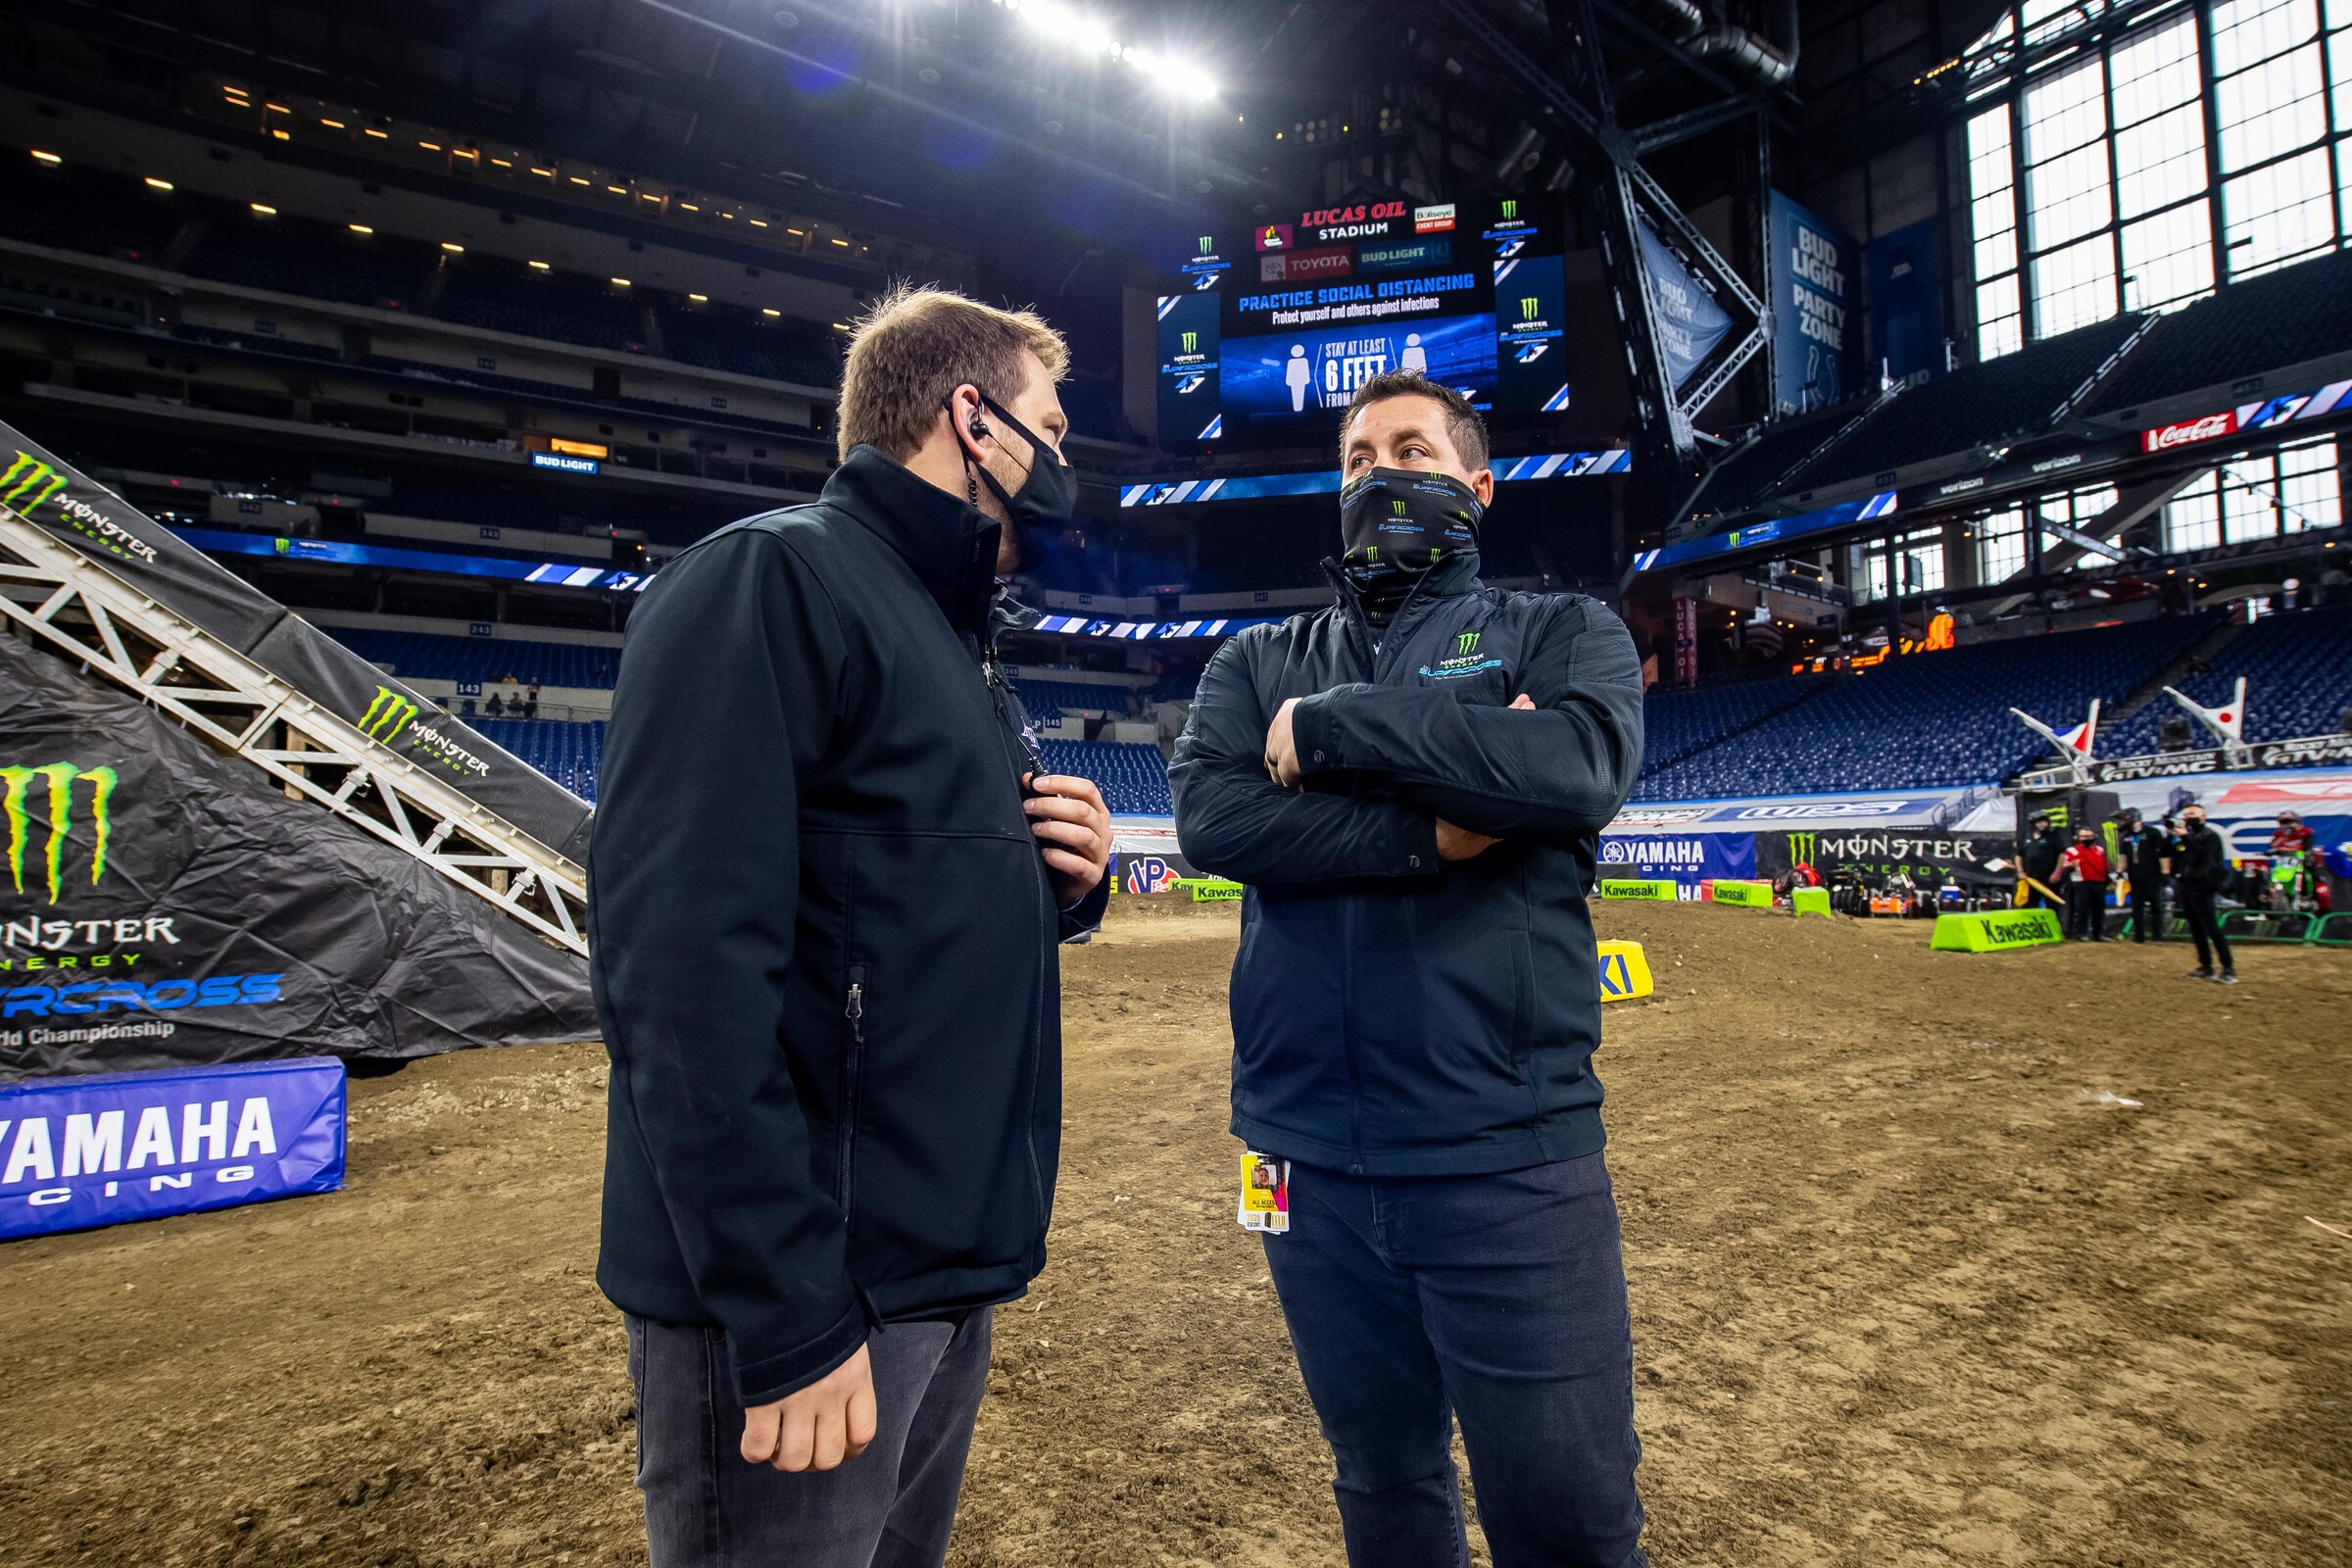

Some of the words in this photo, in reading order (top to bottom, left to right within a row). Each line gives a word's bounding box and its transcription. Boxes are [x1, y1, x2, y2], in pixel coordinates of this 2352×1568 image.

[1301, 205, 1366, 227] LUCAS
[1372, 201, 1406, 219] OIL
[1319, 222, 1389, 240] STADIUM
[1361, 252, 1388, 263] BUD
[1389, 247, 1425, 260] LIGHT
[1798, 225, 1838, 268] BUD
[1291, 255, 1350, 271] TOYOTA
[1791, 247, 1844, 295] LIGHT
[1239, 293, 1313, 312] PRACTICE
[1319, 284, 1374, 304] SOCIAL
[1378, 273, 1474, 297] DISTANCING
[1272, 311, 1299, 324] Protect
[1299, 307, 1331, 323] yourself
[1331, 305, 1346, 318] and
[1347, 302, 1371, 317] others
[1372, 299, 1400, 316] against
[1400, 296, 1439, 312] infections
[1792, 283, 1845, 329] PARTY
[1800, 312, 1842, 351] ZONE
[1326, 342, 1346, 358] STAY
[1348, 340, 1357, 356] AT
[1359, 338, 1386, 355] LEAST
[1326, 359, 1339, 392] 6
[1343, 355, 1388, 391] FEET
[1326, 392, 1351, 408] FROM
[535, 455, 560, 466] BUD
[561, 458, 594, 471] LIGHT
[2033, 454, 2082, 472] verizon
[1940, 477, 1984, 494] verizon
[54, 493, 158, 564] MONSTER
[59, 513, 134, 560] ENERGY
[470, 625, 490, 635] 243
[1419, 660, 1502, 676] SUPERCROSS
[1441, 653, 1485, 666] MONSTER
[459, 683, 480, 695] 143
[1047, 718, 1060, 728] 145
[409, 720, 490, 777] MONSTER
[413, 739, 470, 775] ENERGY
[1624, 841, 1704, 863] YAMAHA
[1821, 834, 1978, 862] MONSTER
[1604, 884, 1658, 897] Kawasaki
[1714, 885, 1747, 903] Kawasaki
[1982, 915, 2054, 945] Kawasaki
[28, 1020, 175, 1046] Championship
[1247, 1213, 1261, 1223] 2020
